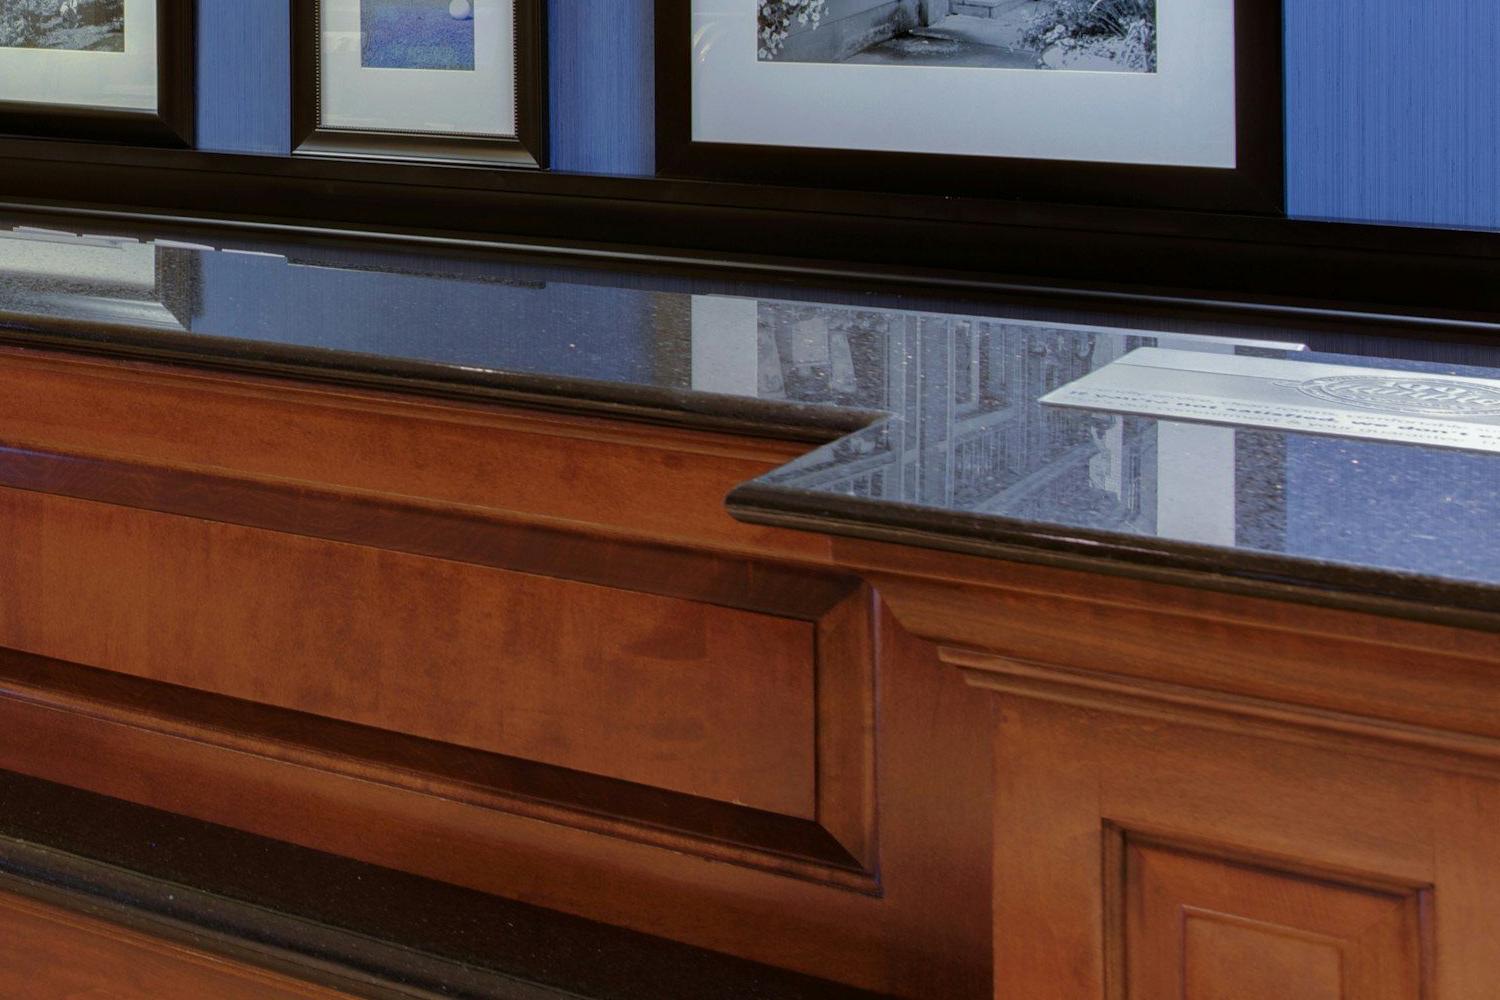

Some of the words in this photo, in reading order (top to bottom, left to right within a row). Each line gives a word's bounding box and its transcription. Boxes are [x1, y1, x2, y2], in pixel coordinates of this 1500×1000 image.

[1176, 402, 1218, 411] not
[1351, 420, 1388, 428] we
[1397, 425, 1468, 437] don't
